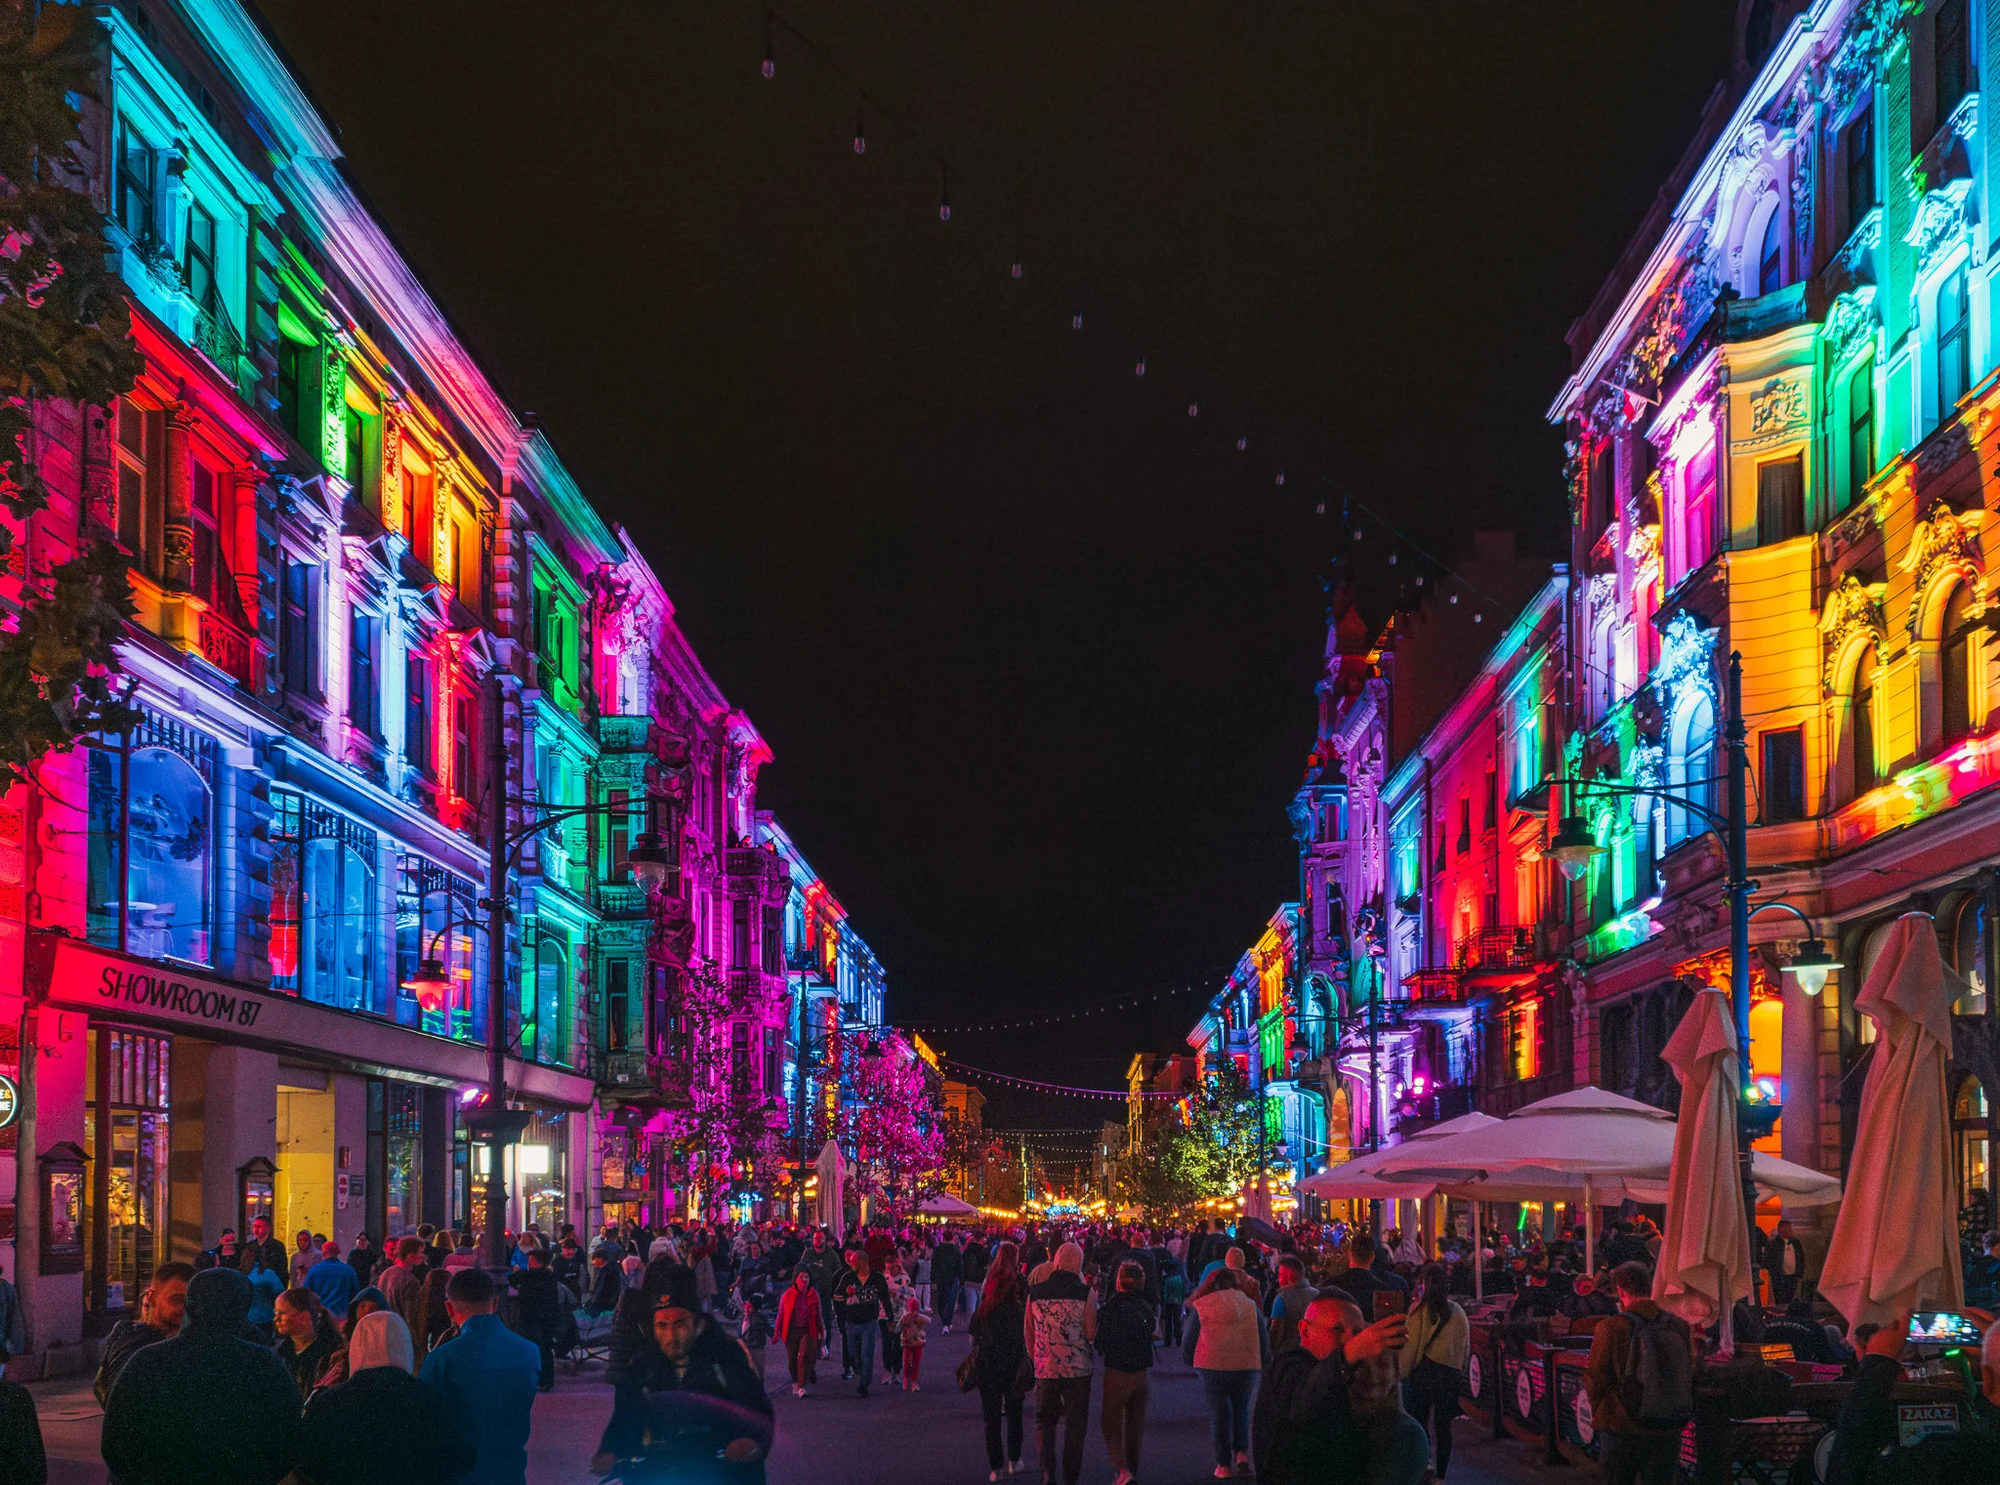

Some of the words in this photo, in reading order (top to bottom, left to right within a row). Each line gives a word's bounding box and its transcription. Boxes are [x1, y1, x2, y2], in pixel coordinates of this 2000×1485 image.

[98, 967, 237, 1023] SHOWROOM
[237, 1001, 263, 1027] 87
[1904, 1408, 1953, 1420] ZAKAZ
